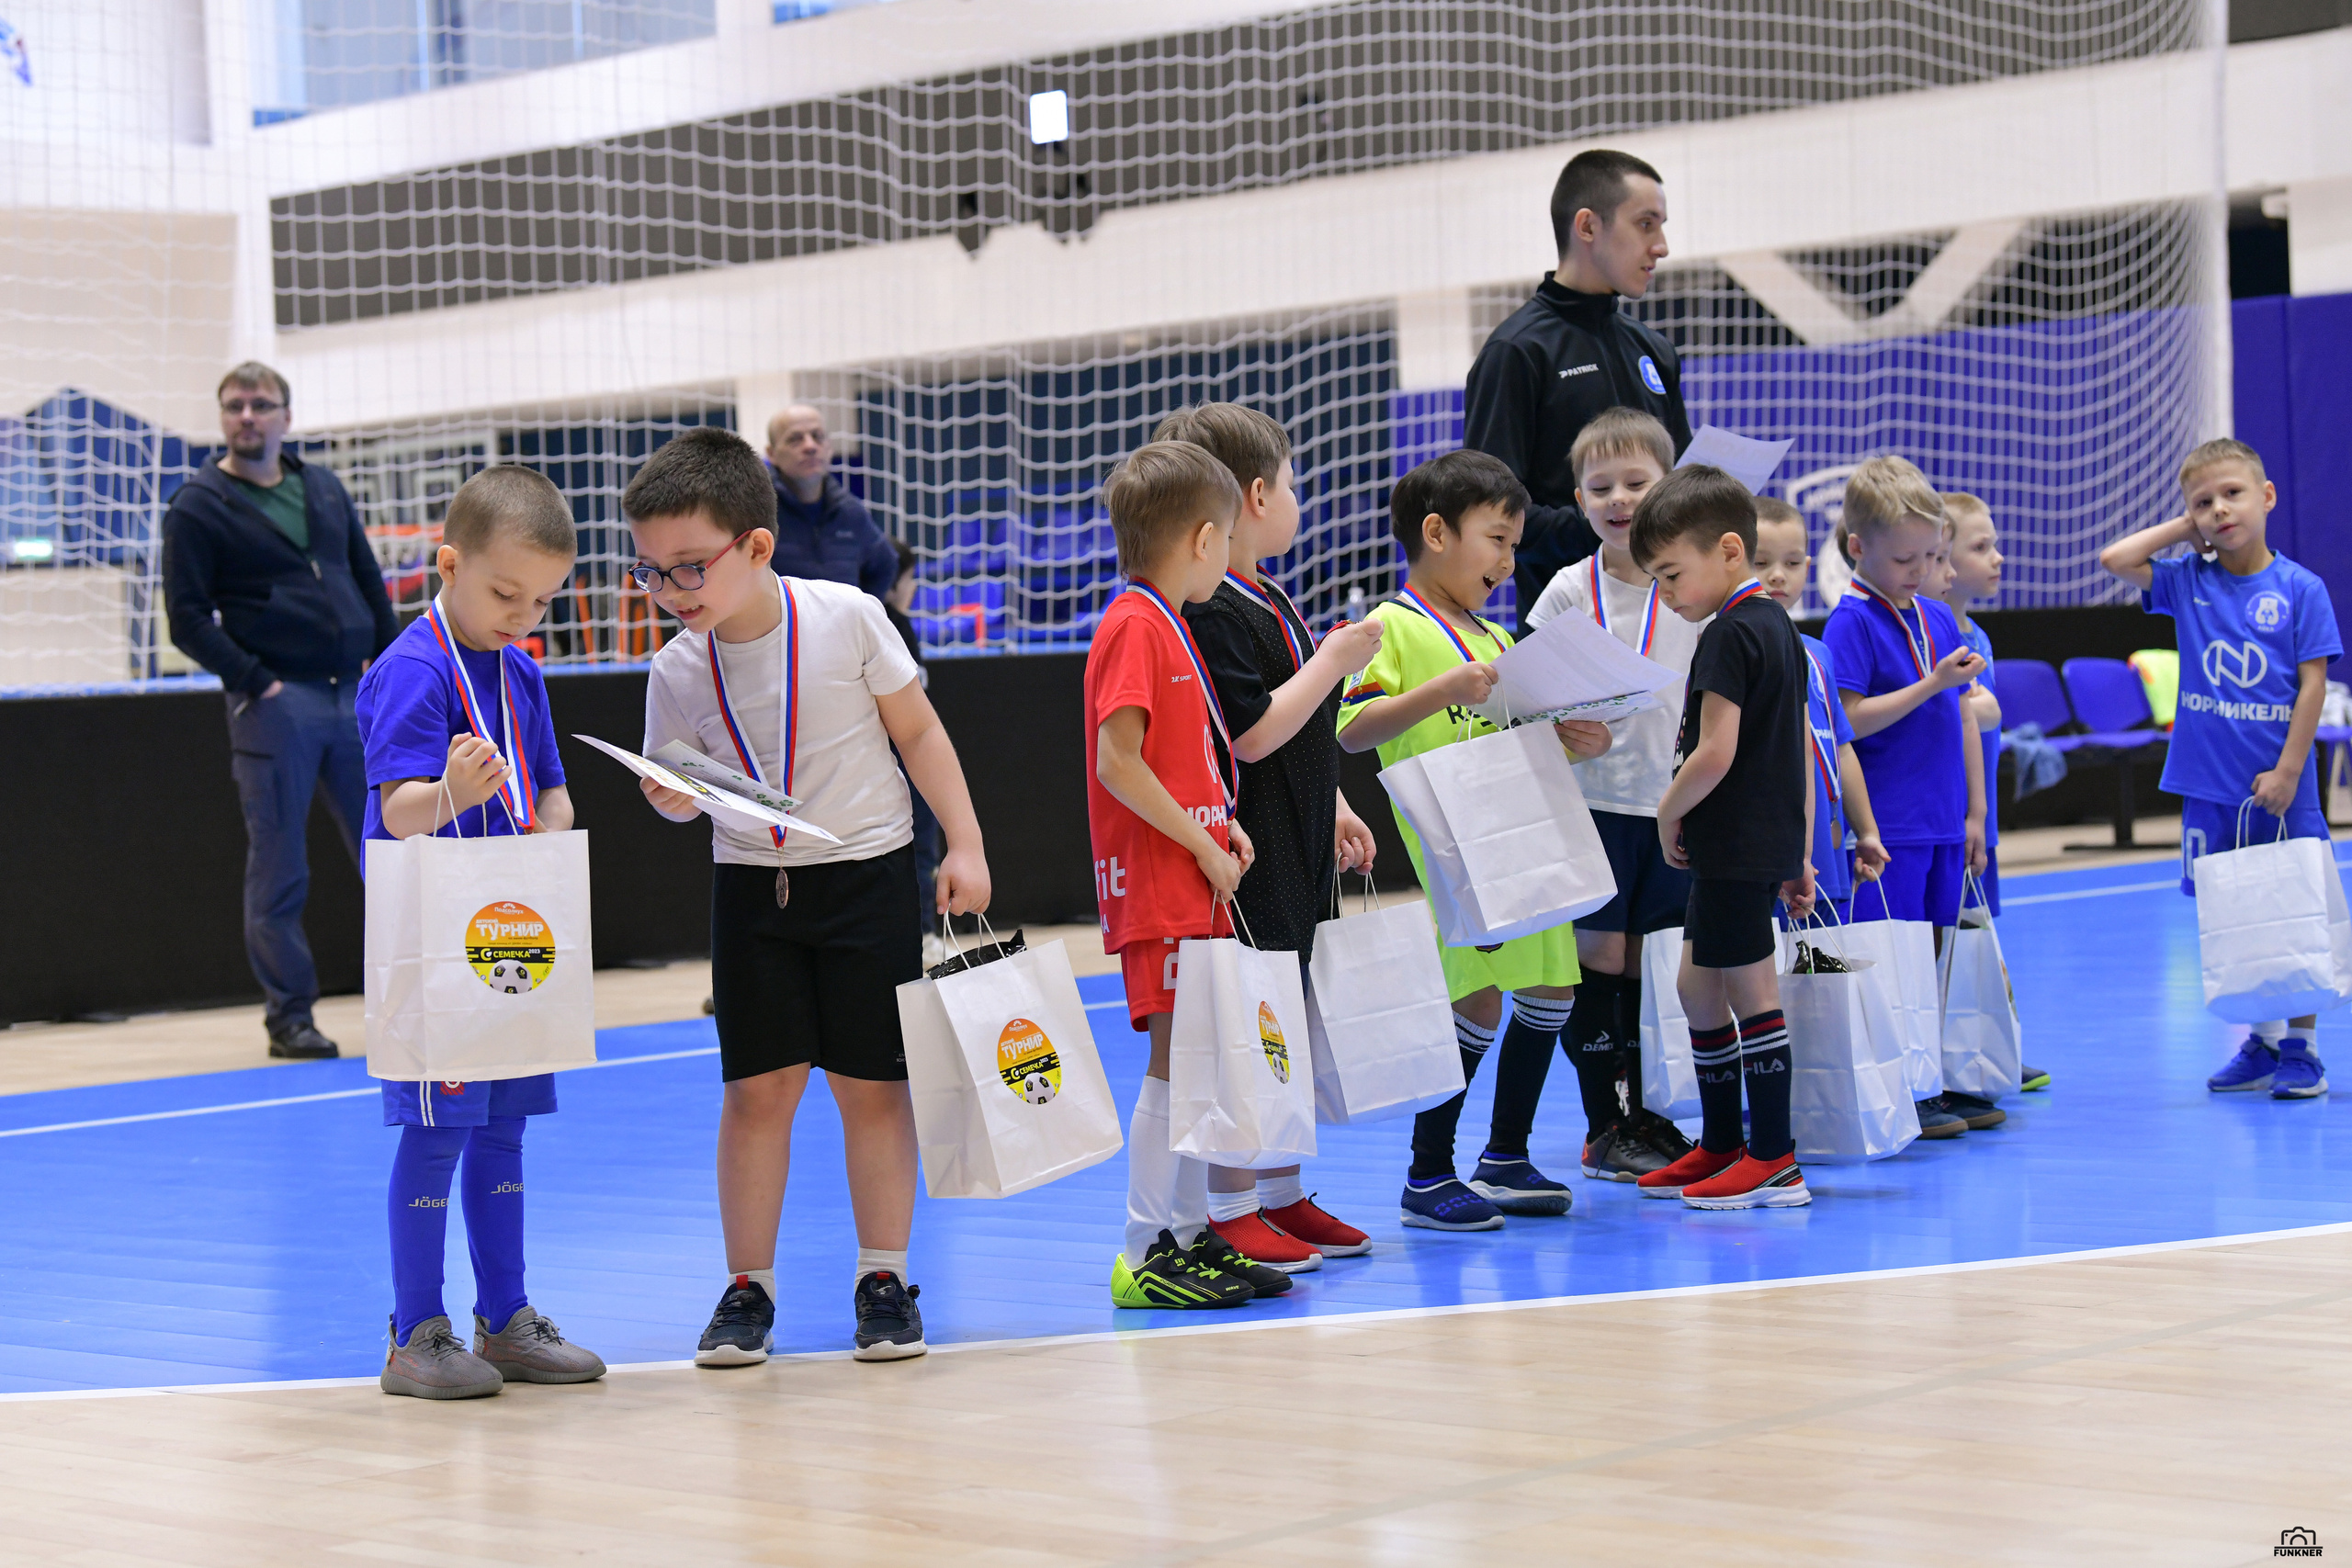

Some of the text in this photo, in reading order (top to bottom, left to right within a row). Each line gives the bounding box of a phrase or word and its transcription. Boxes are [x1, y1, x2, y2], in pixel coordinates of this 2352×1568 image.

[1567, 364, 1599, 376] PATRICK
[2181, 691, 2292, 722] НОРНИКЕЛЬ
[476, 923, 544, 941] ТУРНИР
[493, 950, 531, 958] СЕМЕЧКА
[1001, 1033, 1044, 1060] ТУРНИР
[1019, 1061, 1045, 1075] СЕМЕЧКА
[408, 1196, 448, 1208] JÖGE
